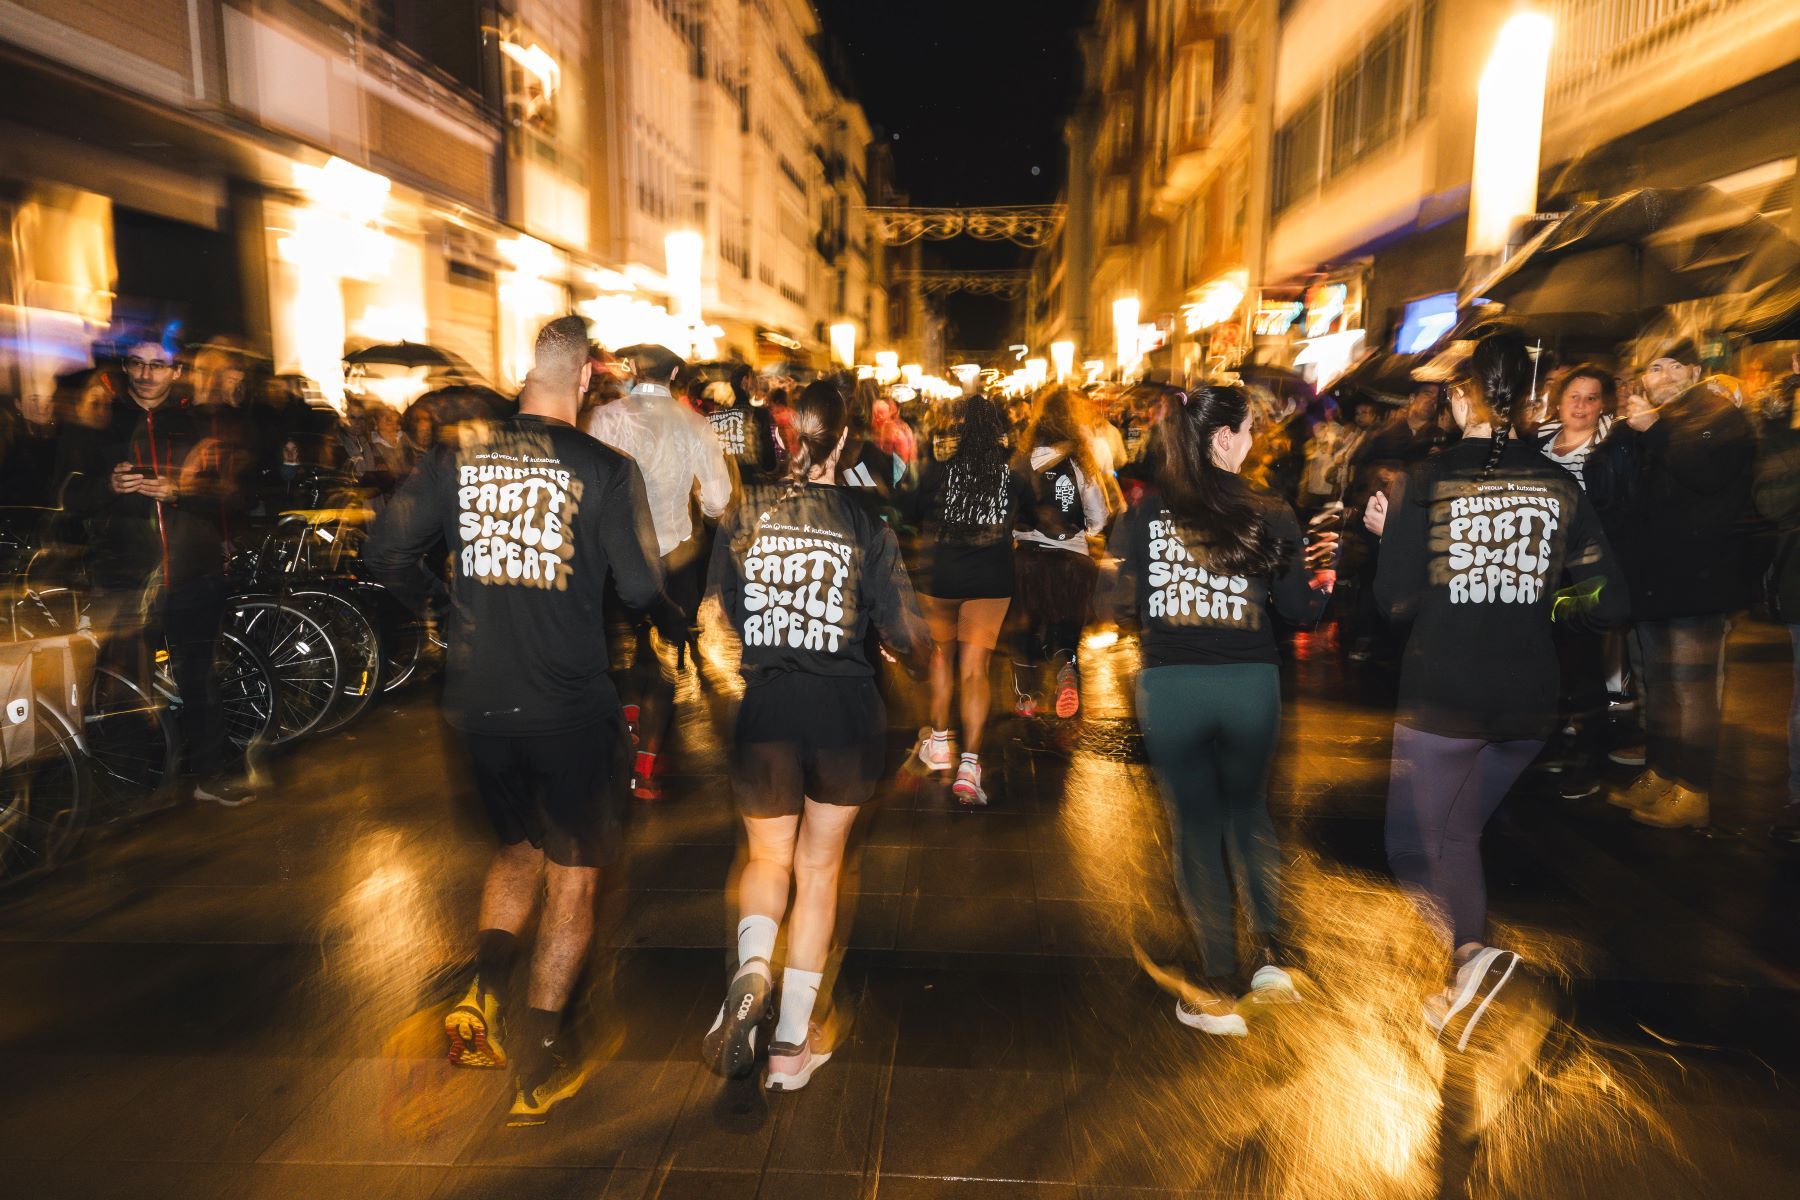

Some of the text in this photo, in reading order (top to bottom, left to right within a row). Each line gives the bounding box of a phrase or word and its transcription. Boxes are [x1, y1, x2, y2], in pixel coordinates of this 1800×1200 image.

[712, 416, 744, 433] ARTY
[499, 454, 519, 462] VEOLIA
[719, 441, 746, 456] PEAT
[457, 477, 566, 514] PARTY
[459, 464, 571, 491] RUNNING
[1067, 484, 1075, 505] FACE
[1516, 484, 1548, 493] kutxabank
[1061, 486, 1069, 512] NORTH
[1450, 496, 1560, 518] RUNNING
[458, 507, 563, 551] SMILE
[1449, 507, 1558, 543] PARTY
[460, 536, 562, 581] REPEAT
[743, 550, 849, 588] PARTY
[1448, 536, 1551, 575] SMILE
[743, 580, 844, 624] SMILE
[1148, 581, 1248, 621] REPEAT
[743, 606, 844, 653] REPEAT
